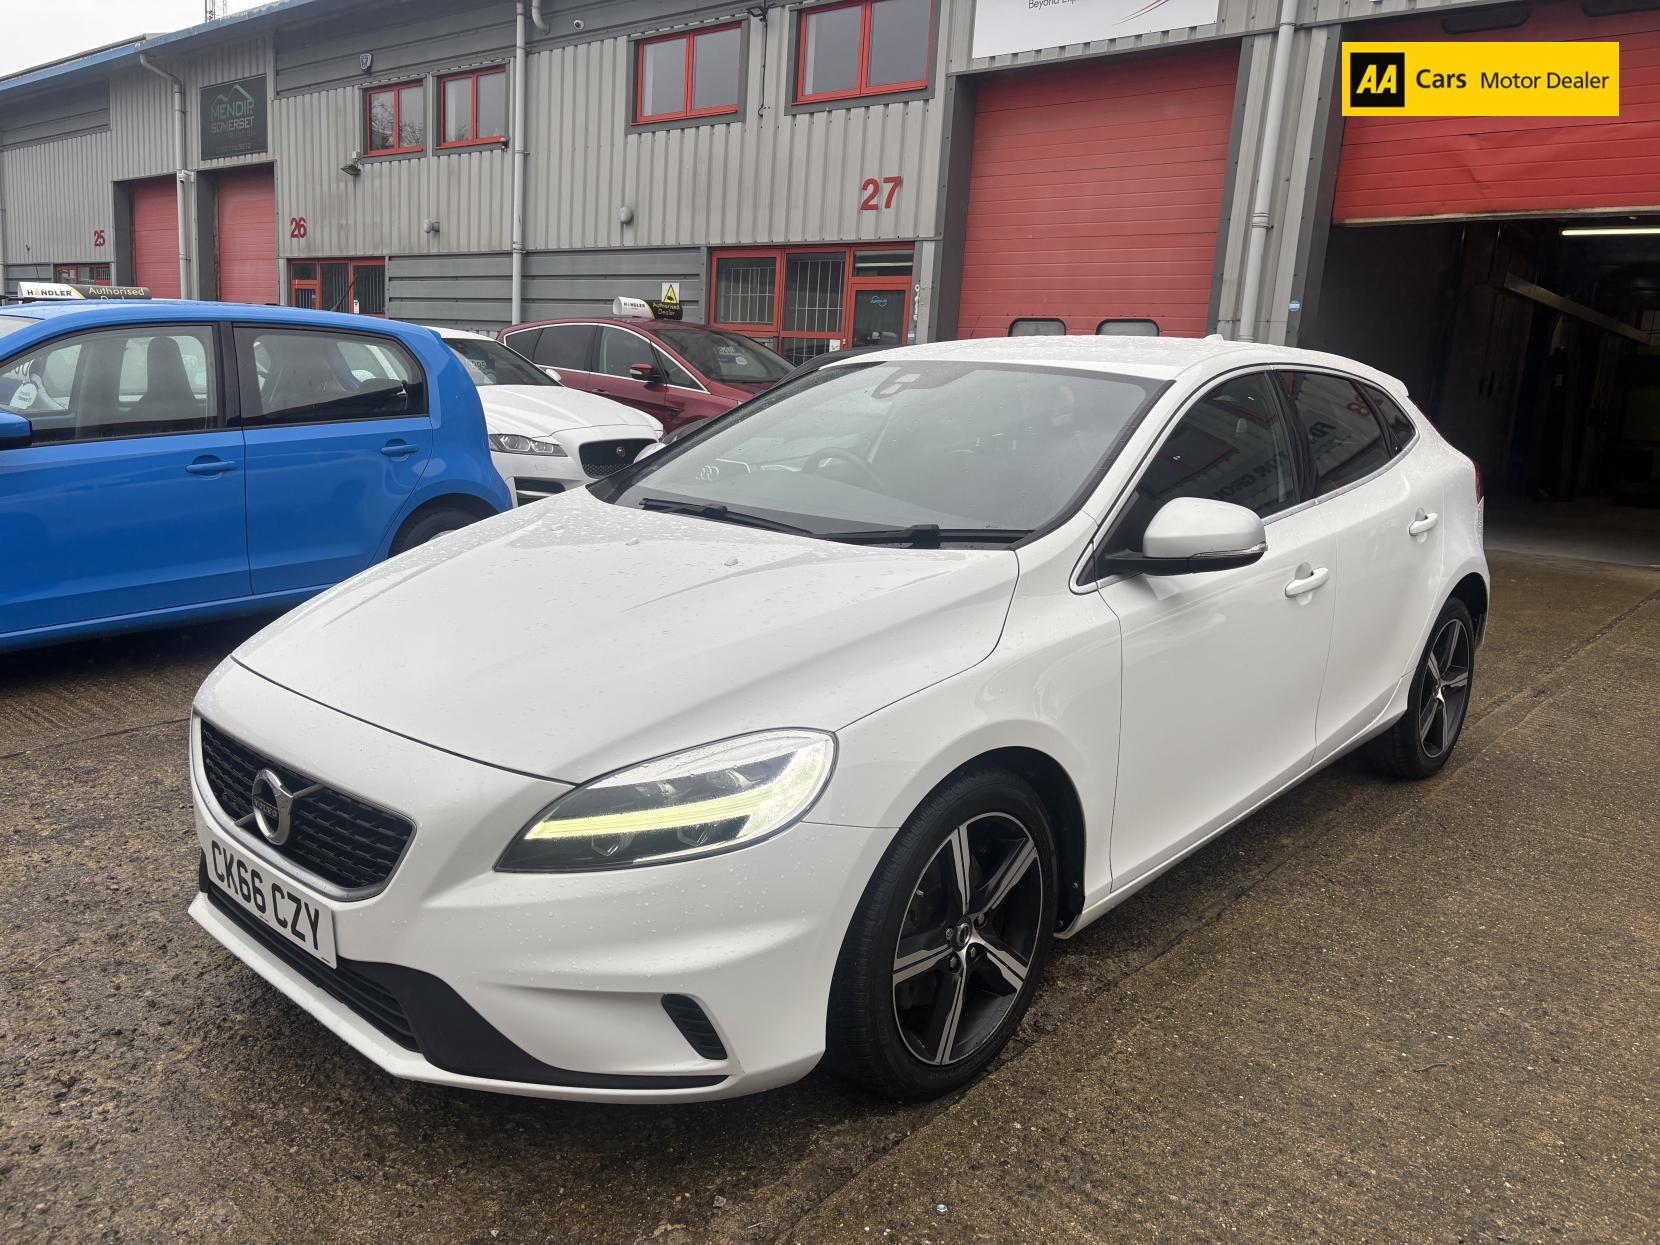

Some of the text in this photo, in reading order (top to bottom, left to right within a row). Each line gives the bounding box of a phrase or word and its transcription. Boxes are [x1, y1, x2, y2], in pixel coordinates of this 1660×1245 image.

[210, 99, 256, 121] MENDIP
[210, 116, 255, 134] SOMERSET
[860, 175, 902, 211] 27
[93, 229, 106, 247] 25
[290, 216, 308, 239] 26
[88, 286, 145, 297] Authorised
[211, 839, 320, 951] CK66 CZY
